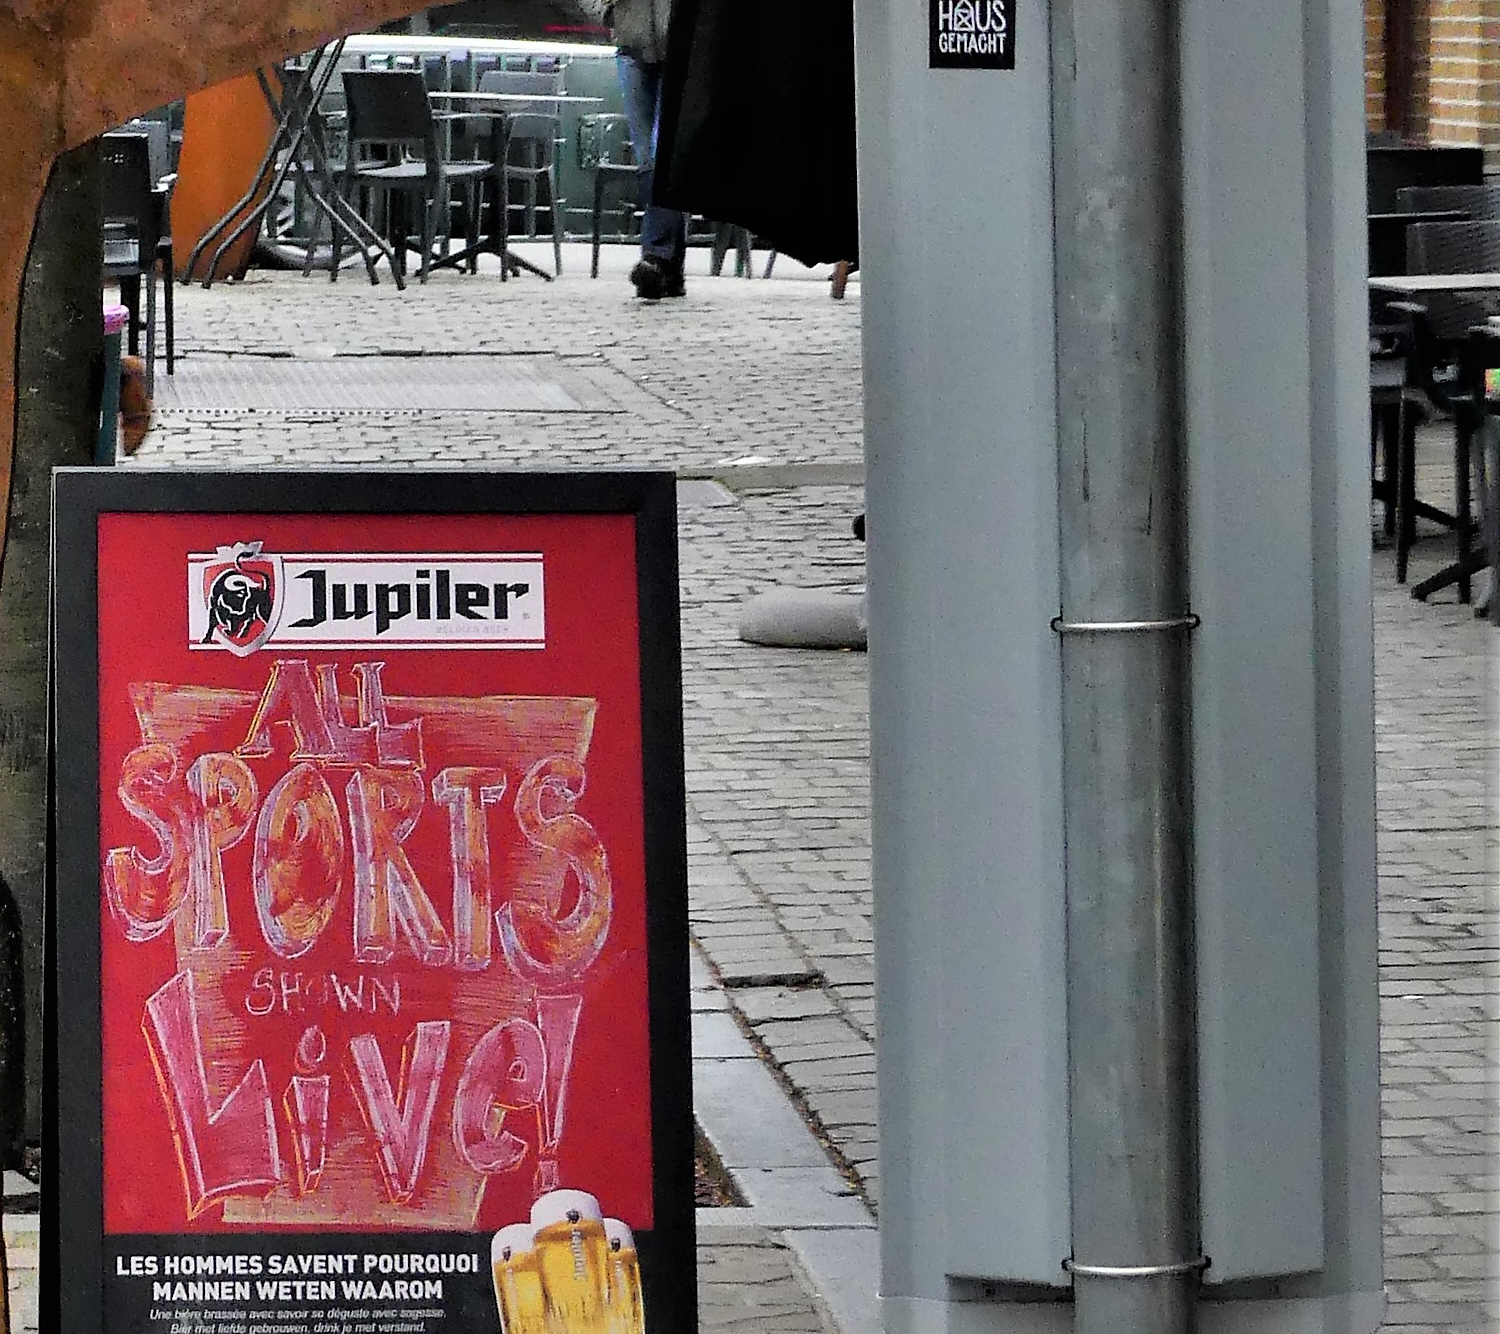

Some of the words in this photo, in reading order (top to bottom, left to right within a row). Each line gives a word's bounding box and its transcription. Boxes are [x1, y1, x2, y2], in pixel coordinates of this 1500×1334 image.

[938, 32, 1007, 54] GEMACHT
[288, 569, 530, 636] Jupiler
[233, 659, 426, 771] ALL
[106, 743, 613, 973] SPORTS
[116, 1256, 158, 1276] LES
[164, 1255, 262, 1276] HOMMES
[268, 1254, 358, 1275] SAVENT
[363, 1254, 479, 1274] POURQUOI
[153, 1280, 250, 1302] MANNEN
[255, 1280, 336, 1301] WETEN
[341, 1279, 443, 1300] WAAROM
[150, 1309, 172, 1321] Une
[313, 1322, 339, 1334] drink
